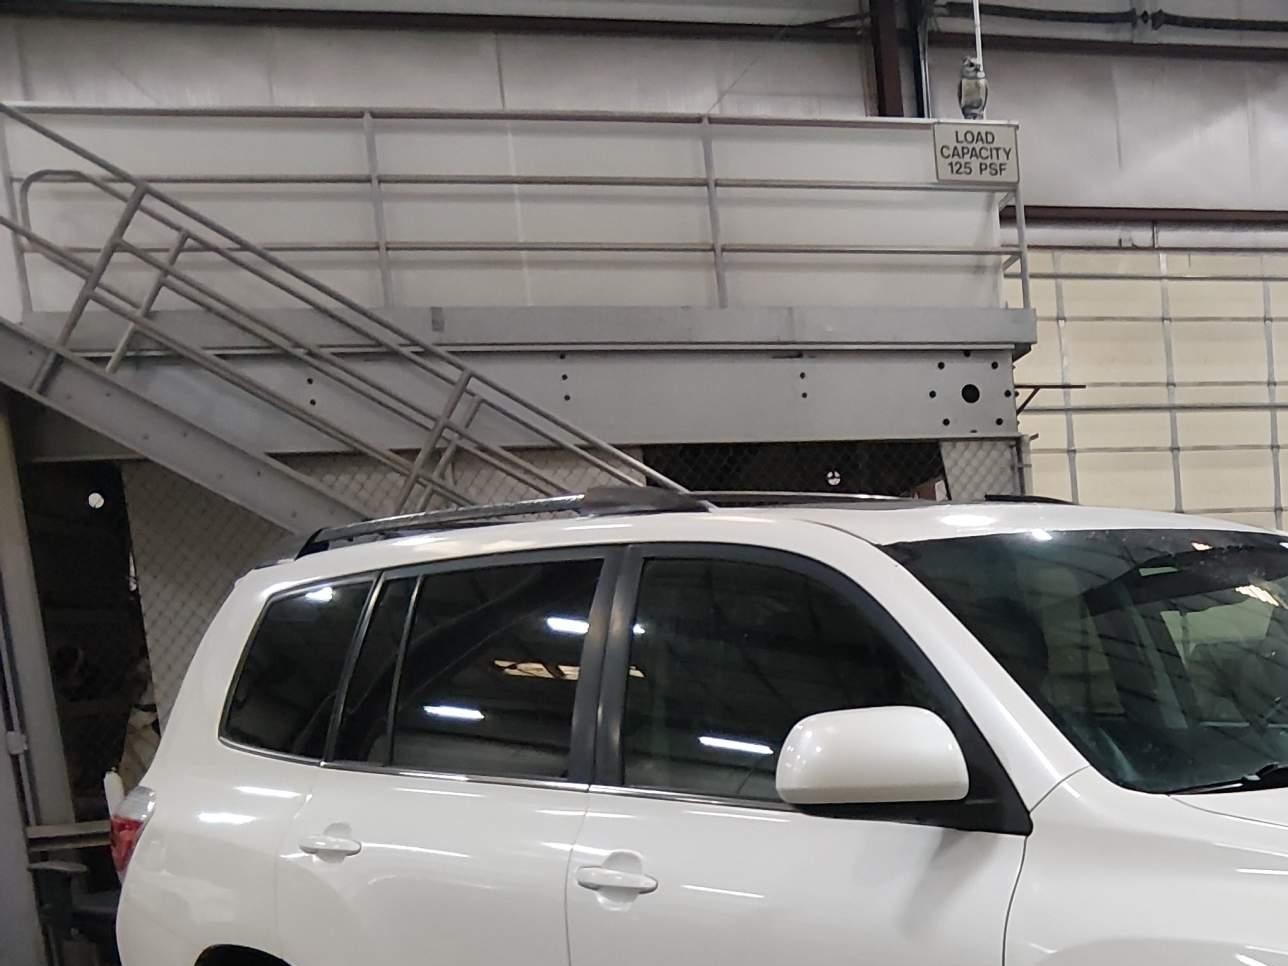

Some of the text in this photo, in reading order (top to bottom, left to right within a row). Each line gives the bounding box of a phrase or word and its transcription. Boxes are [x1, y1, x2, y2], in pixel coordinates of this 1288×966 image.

[955, 130, 995, 144] LOAD
[940, 145, 1011, 161] CAPACITY
[948, 161, 1008, 176] 125 PSF
